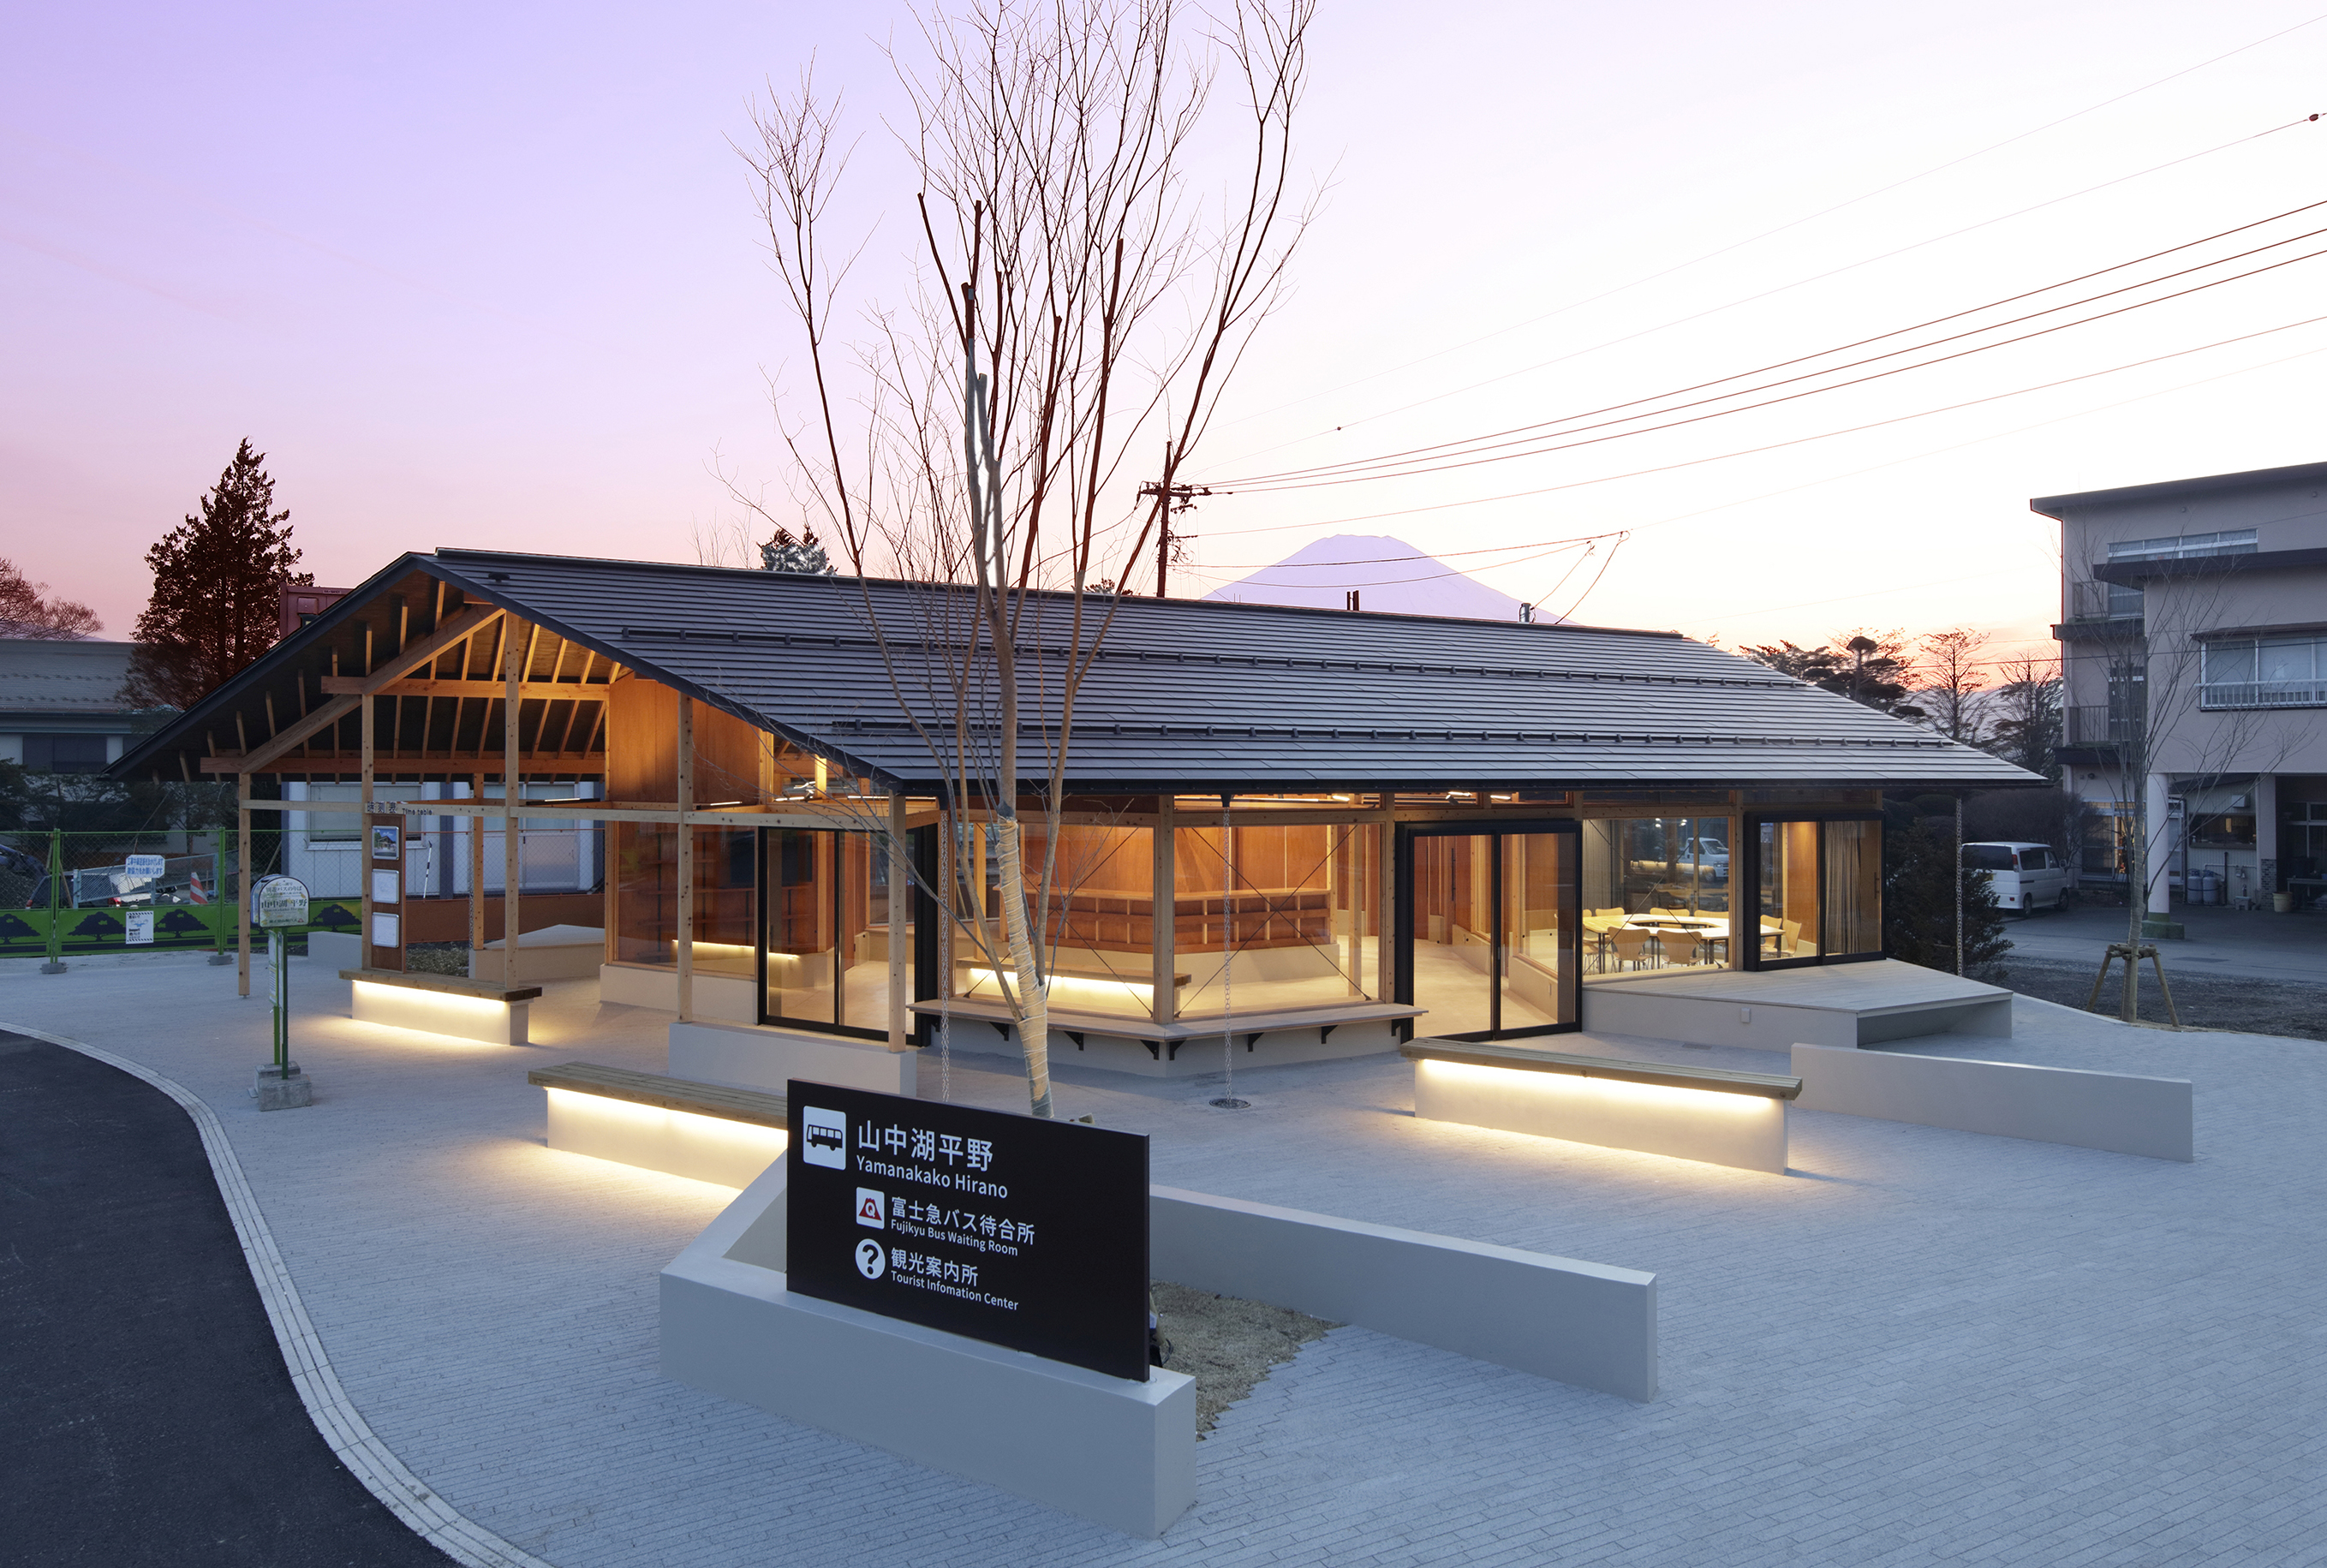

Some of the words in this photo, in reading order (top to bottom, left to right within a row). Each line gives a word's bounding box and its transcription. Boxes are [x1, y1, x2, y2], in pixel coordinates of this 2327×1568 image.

[367, 801, 397, 814] 時刻表
[858, 1119, 993, 1172] 山中湖平野
[856, 1154, 951, 1188] Yamanakako
[955, 1173, 1008, 1199] Hirano
[891, 1219, 926, 1238] Fujikyu
[928, 1226, 946, 1241] Bus
[947, 1231, 987, 1252] Waiting
[988, 1239, 1018, 1256] Room
[892, 1196, 1035, 1245] 富士急バス待合所
[892, 1247, 979, 1287] 観光案内所
[891, 1270, 925, 1289] Tourist
[927, 1279, 982, 1303] Infomation
[983, 1292, 1019, 1311] Center
